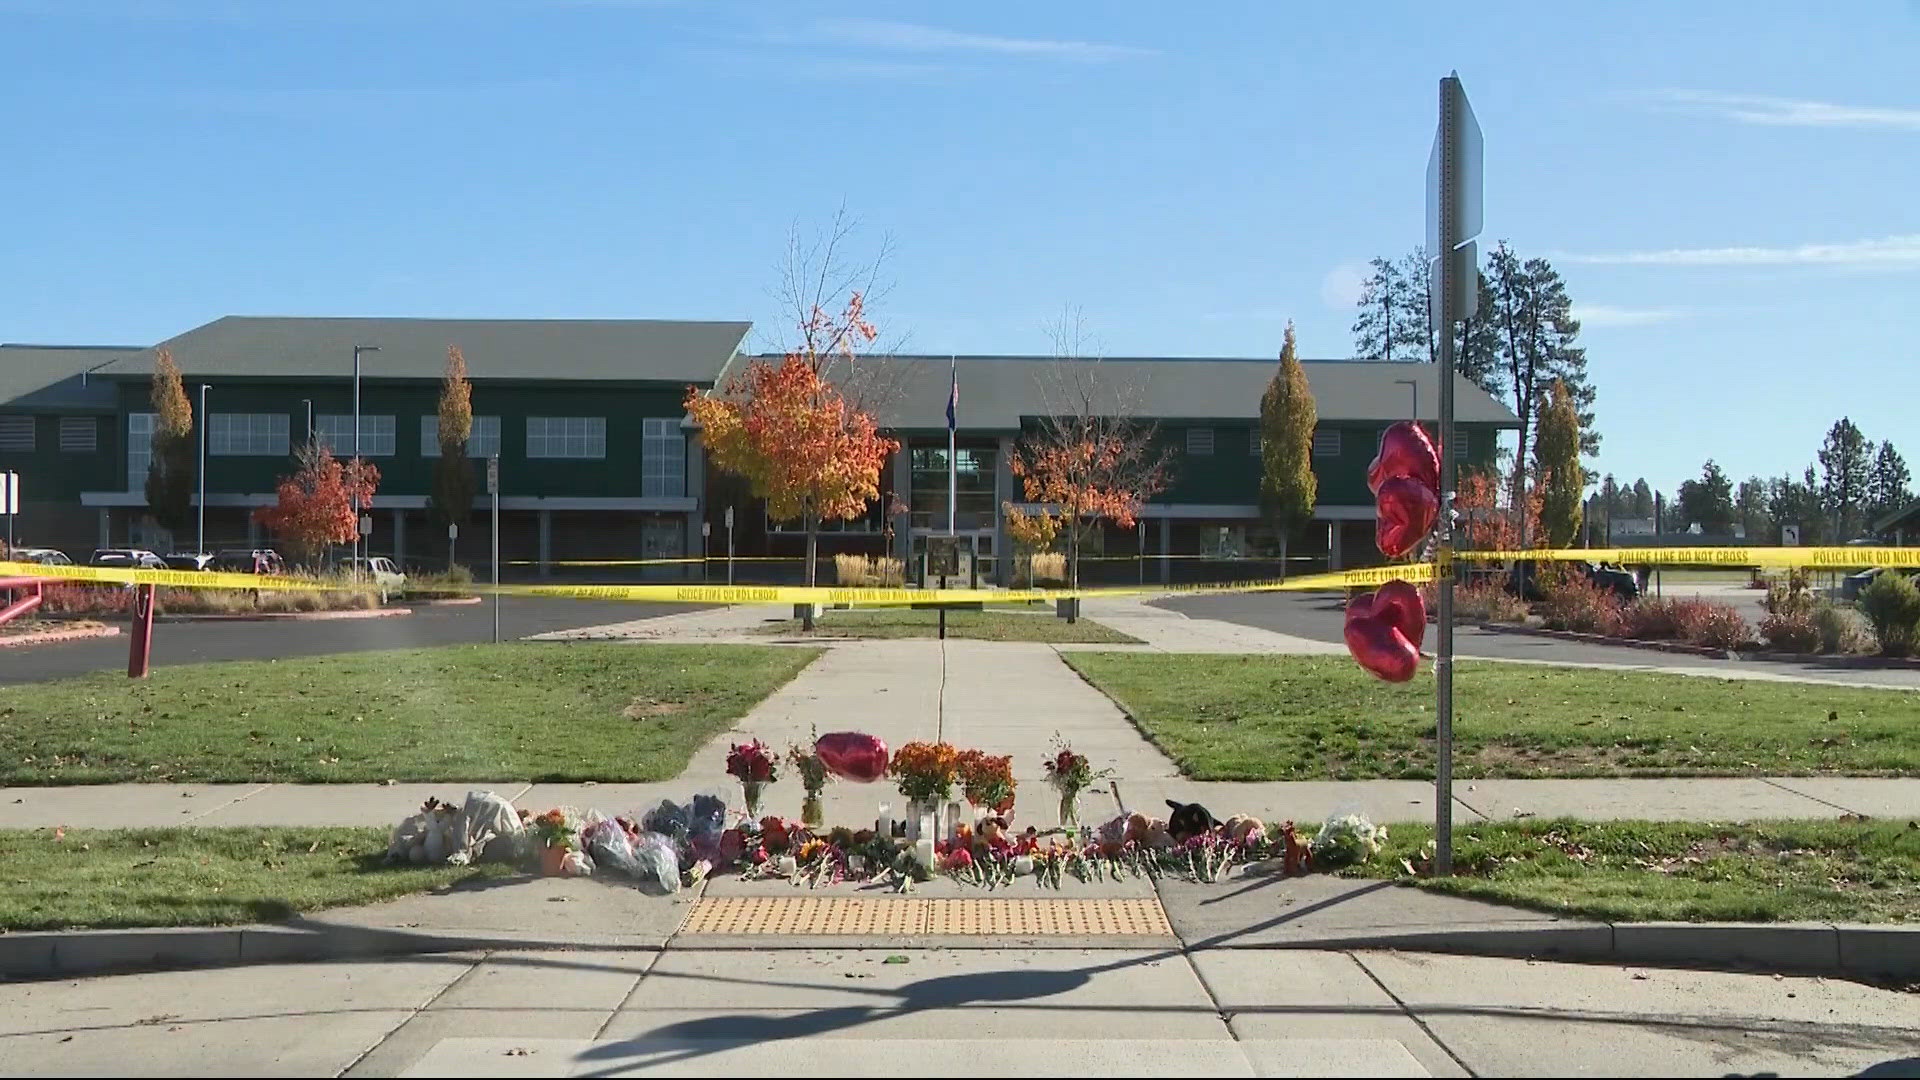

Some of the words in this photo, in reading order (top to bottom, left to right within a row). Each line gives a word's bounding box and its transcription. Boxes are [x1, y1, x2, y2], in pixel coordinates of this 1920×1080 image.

[1618, 550, 1651, 563] POLICE
[1654, 551, 1674, 562] LINE
[1679, 550, 1691, 562] DO
[1694, 550, 1713, 562] NOT
[1716, 551, 1748, 563] CROSS
[1813, 551, 1846, 563] POLICE
[1851, 551, 1872, 563] LINE
[1876, 551, 1889, 563] DO
[1893, 551, 1913, 563] NOT
[1344, 571, 1376, 583] POLICE
[1380, 569, 1399, 581] LINE
[1403, 567, 1416, 580] DO
[1419, 565, 1437, 578] NOT
